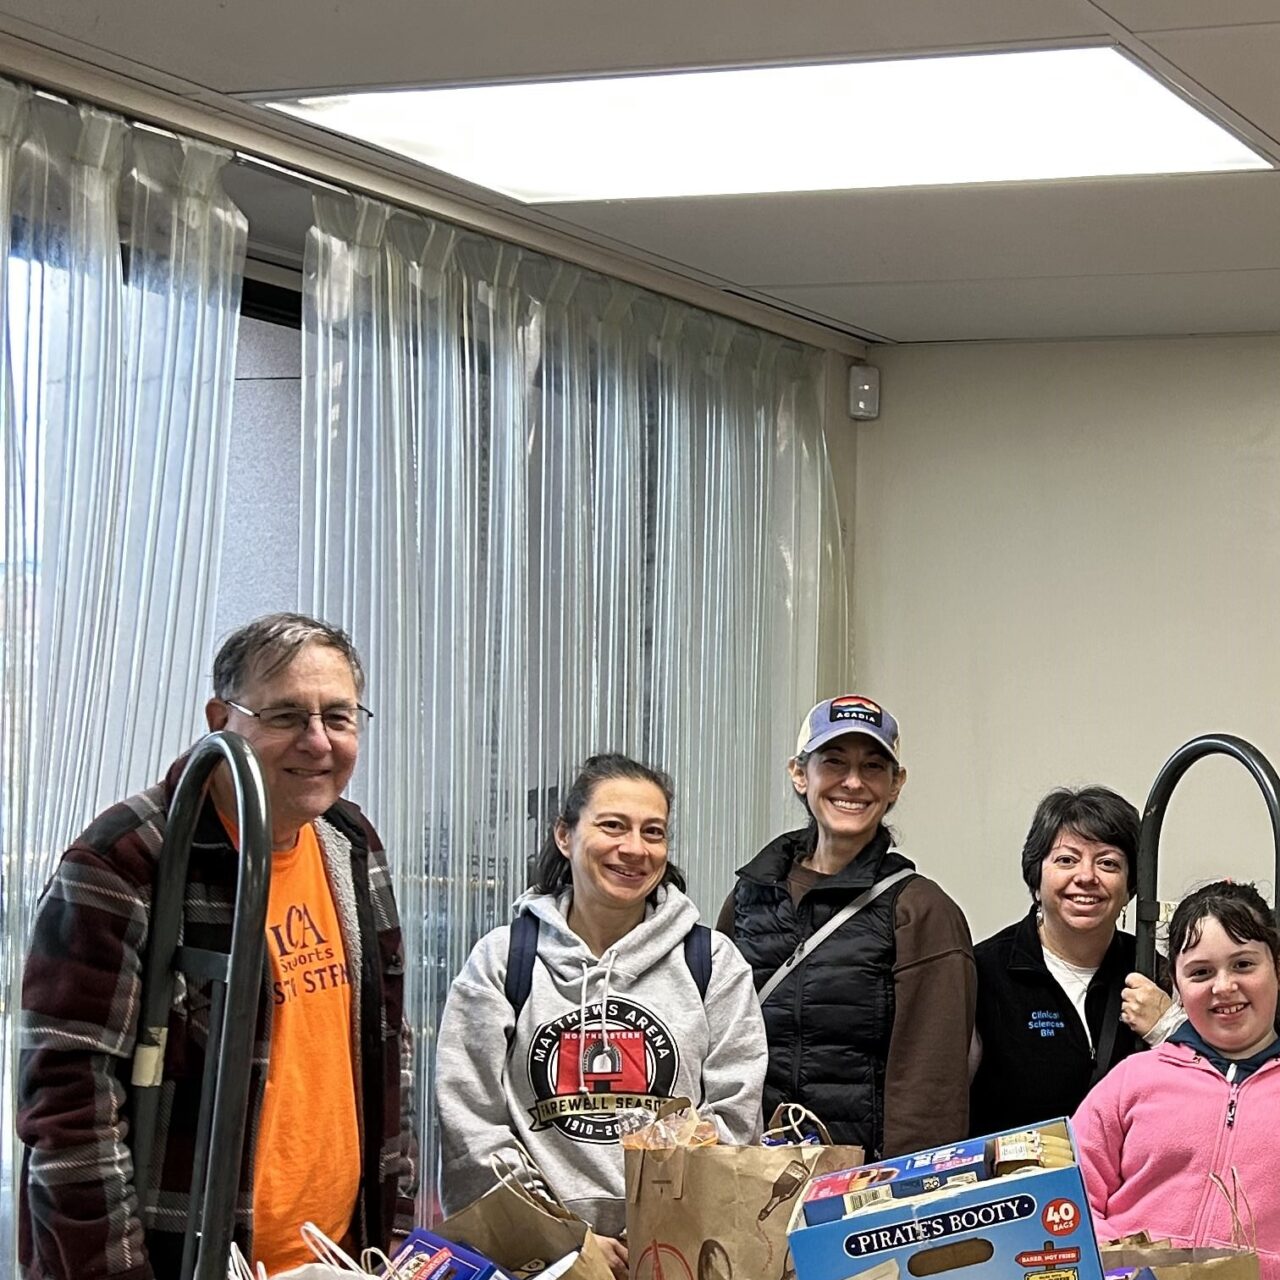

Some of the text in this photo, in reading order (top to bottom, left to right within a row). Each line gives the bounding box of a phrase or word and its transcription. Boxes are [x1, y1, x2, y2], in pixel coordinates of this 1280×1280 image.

[836, 712, 876, 723] ACADIA
[269, 902, 329, 957] ICA
[564, 1031, 641, 1040] NOTHESTERN
[625, 1010, 672, 1059] ARENA
[1028, 1020, 1065, 1030] Sciences
[540, 1096, 668, 1118] FAREWELL SEASO
[1046, 1202, 1075, 1224] 40
[857, 1199, 1021, 1253] PIRATE'S BOOTY
[1053, 1220, 1074, 1232] BAGS
